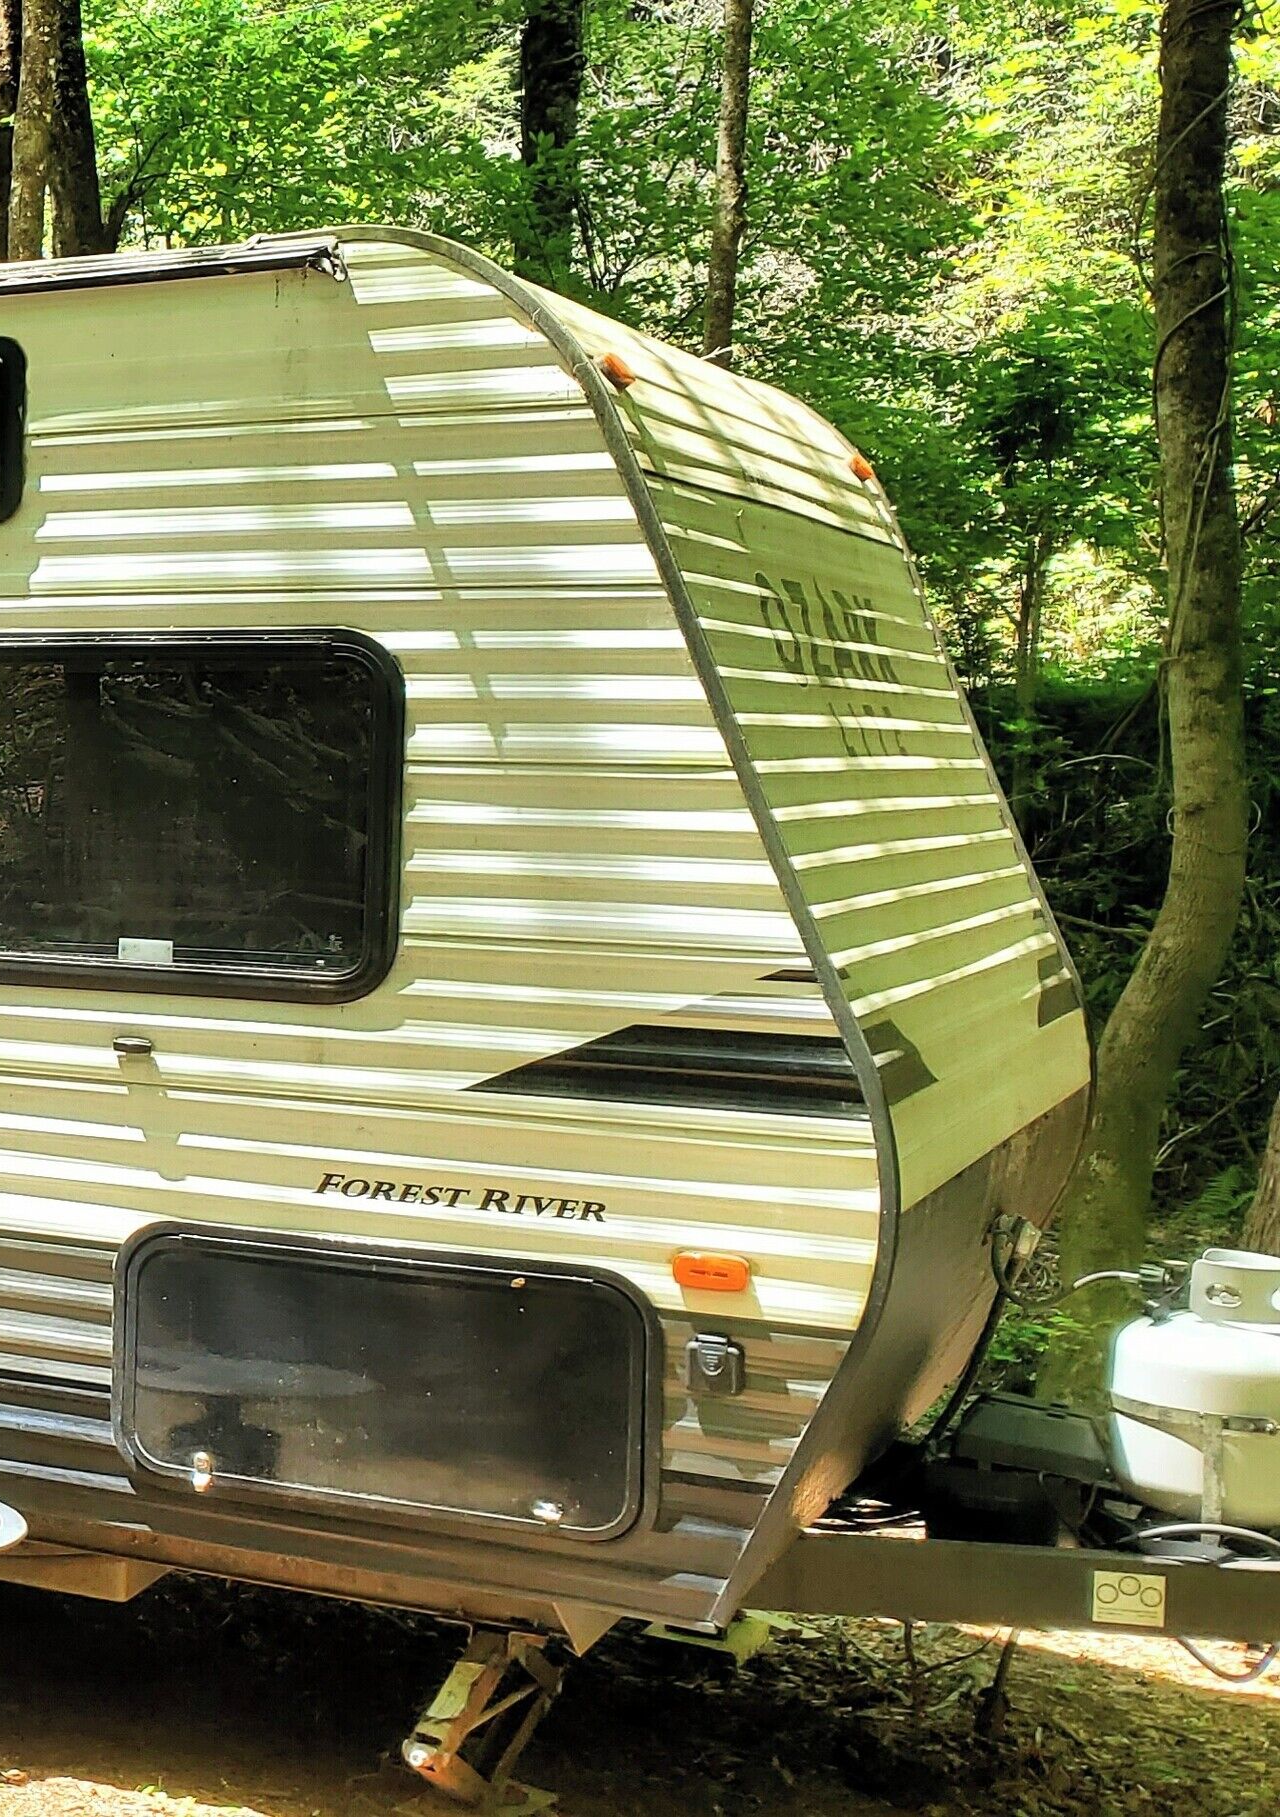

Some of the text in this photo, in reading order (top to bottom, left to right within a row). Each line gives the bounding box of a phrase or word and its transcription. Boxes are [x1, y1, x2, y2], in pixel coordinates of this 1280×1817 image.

[754, 571, 901, 688] OZARK
[828, 701, 908, 758] LITE
[312, 1172, 607, 1223] FOREST RIVER
